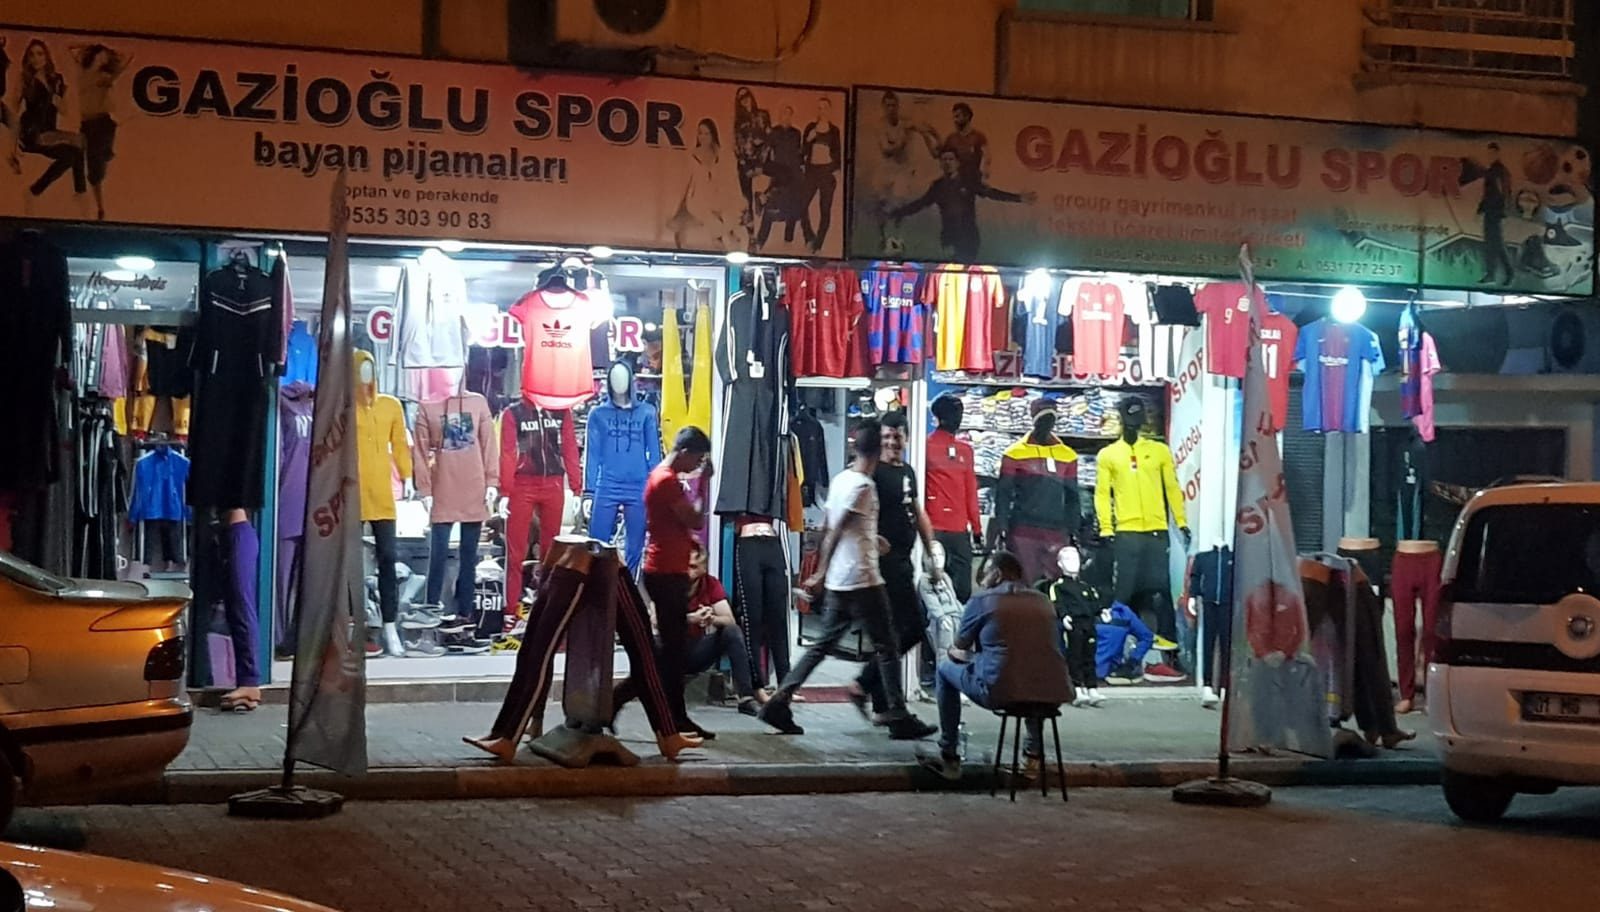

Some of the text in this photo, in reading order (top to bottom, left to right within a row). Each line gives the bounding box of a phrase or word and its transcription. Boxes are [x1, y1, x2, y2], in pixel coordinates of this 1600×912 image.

[133, 64, 686, 150] GAZİOĞLU SPOR
[254, 132, 568, 183] bayan pijamaları
[1015, 123, 1462, 200] GAZİOĞLU SPOR
[345, 186, 499, 204] optan ve perakende
[1053, 193, 1111, 214] group
[395, 208, 430, 227] 303
[437, 210, 460, 228] 90
[467, 212, 491, 229] 83
[1348, 262, 1368, 274] 727
[1224, 307, 1233, 324] 9
[541, 339, 573, 348] adidas
